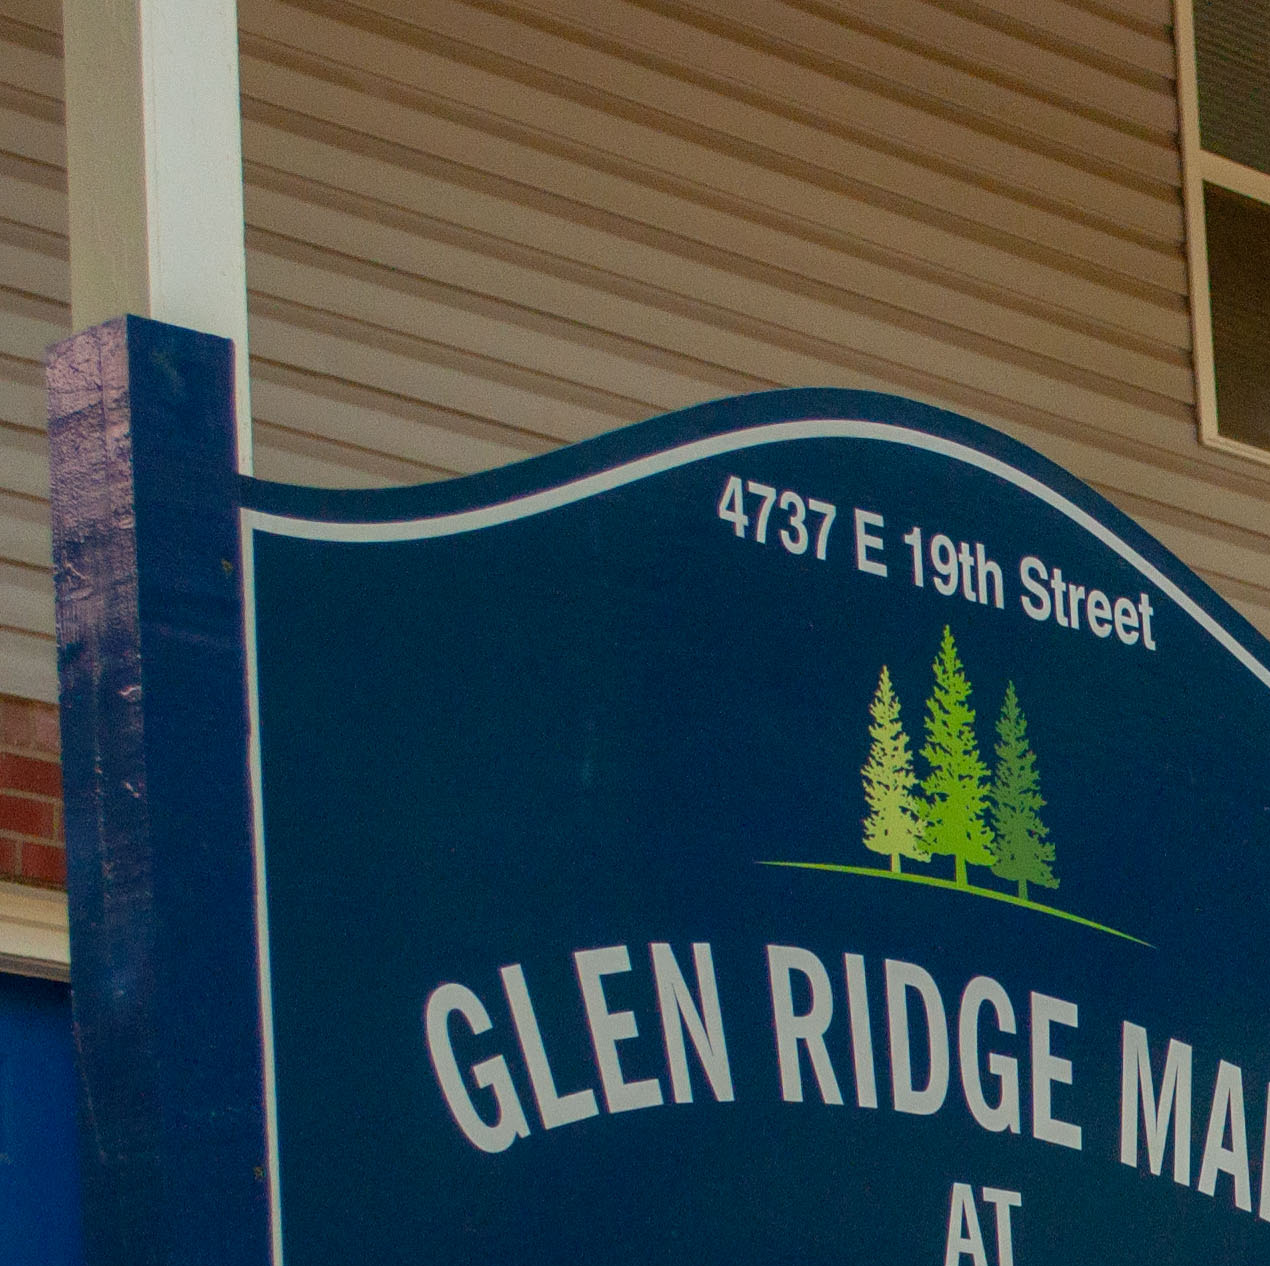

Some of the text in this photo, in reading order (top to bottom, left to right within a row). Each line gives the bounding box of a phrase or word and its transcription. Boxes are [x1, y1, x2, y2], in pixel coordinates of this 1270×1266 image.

[718, 475, 1157, 652] 4737 E 19th Street
[425, 942, 735, 1154] GLEN
[766, 944, 1083, 1151] RIDGE
